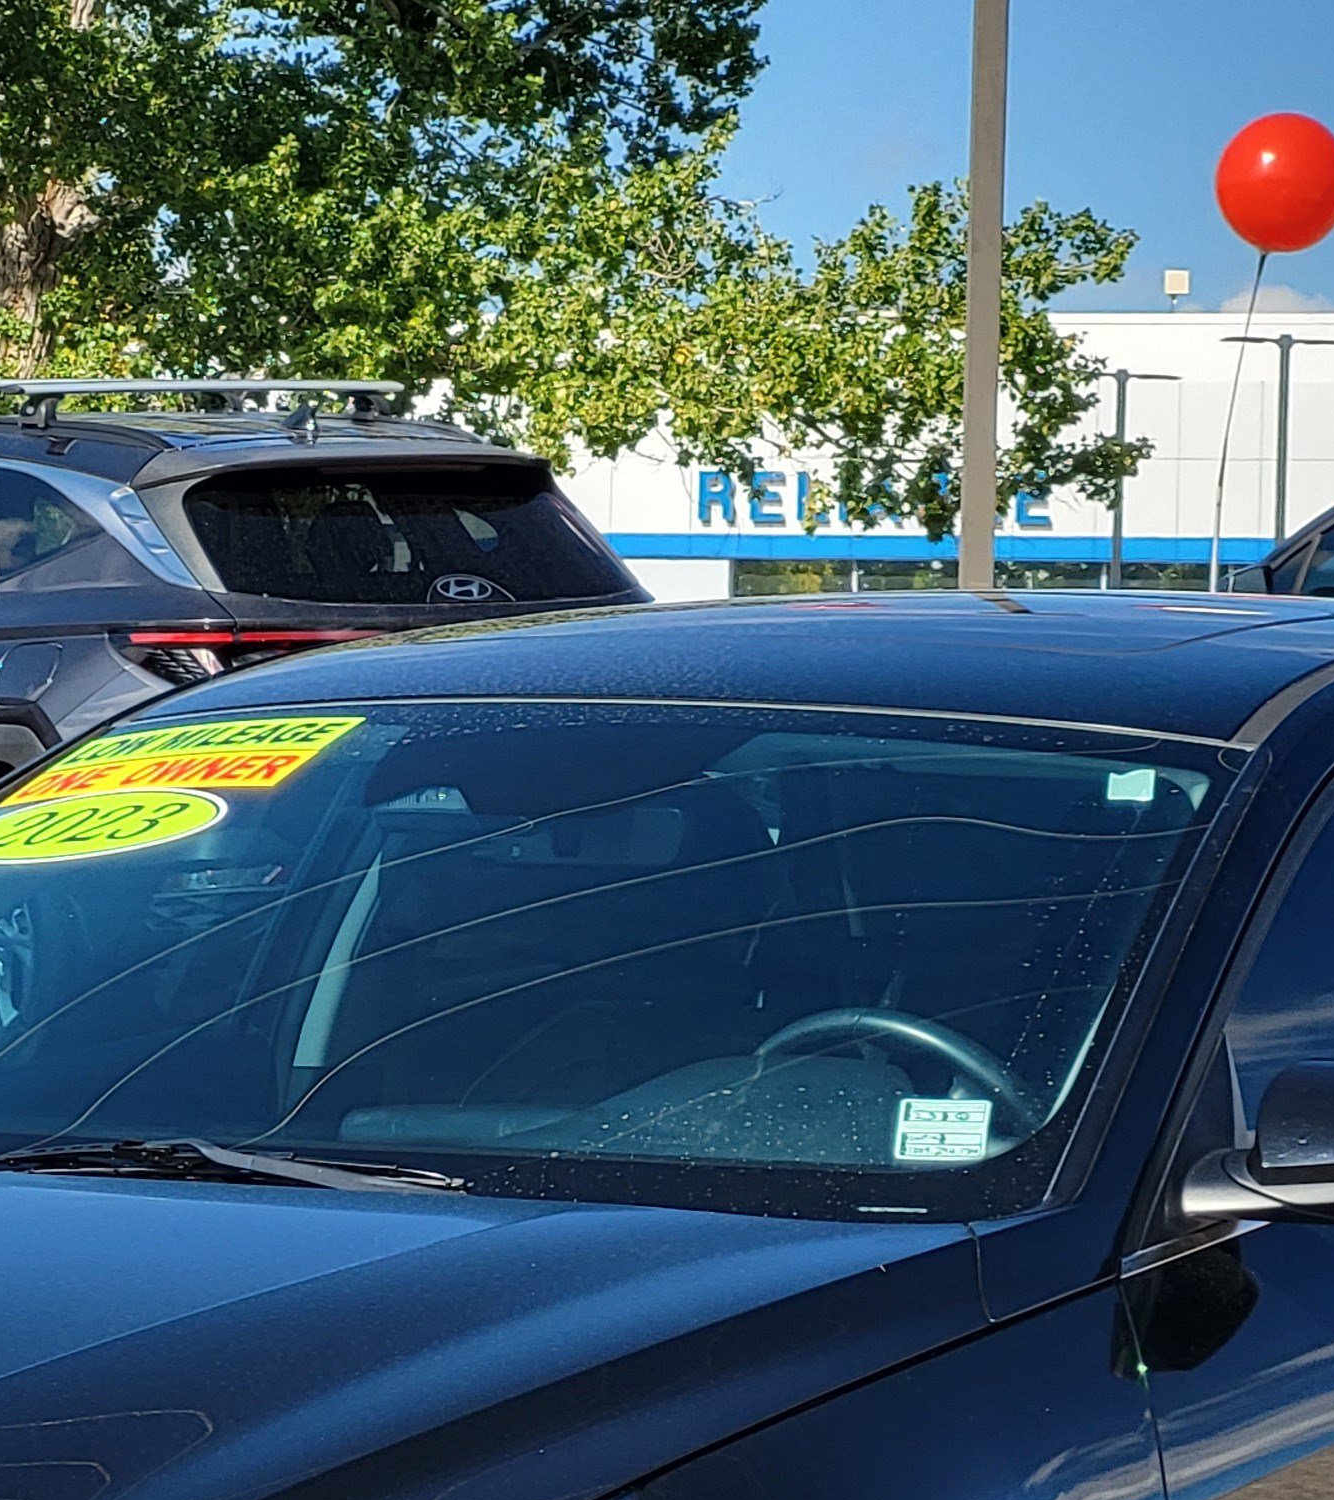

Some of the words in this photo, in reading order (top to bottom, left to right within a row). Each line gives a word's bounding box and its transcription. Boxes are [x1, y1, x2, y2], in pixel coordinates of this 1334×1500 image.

[64, 735, 158, 765] LOW
[155, 721, 340, 751] MILEAGE
[17, 764, 121, 799] ONE
[121, 754, 301, 786] OWNER
